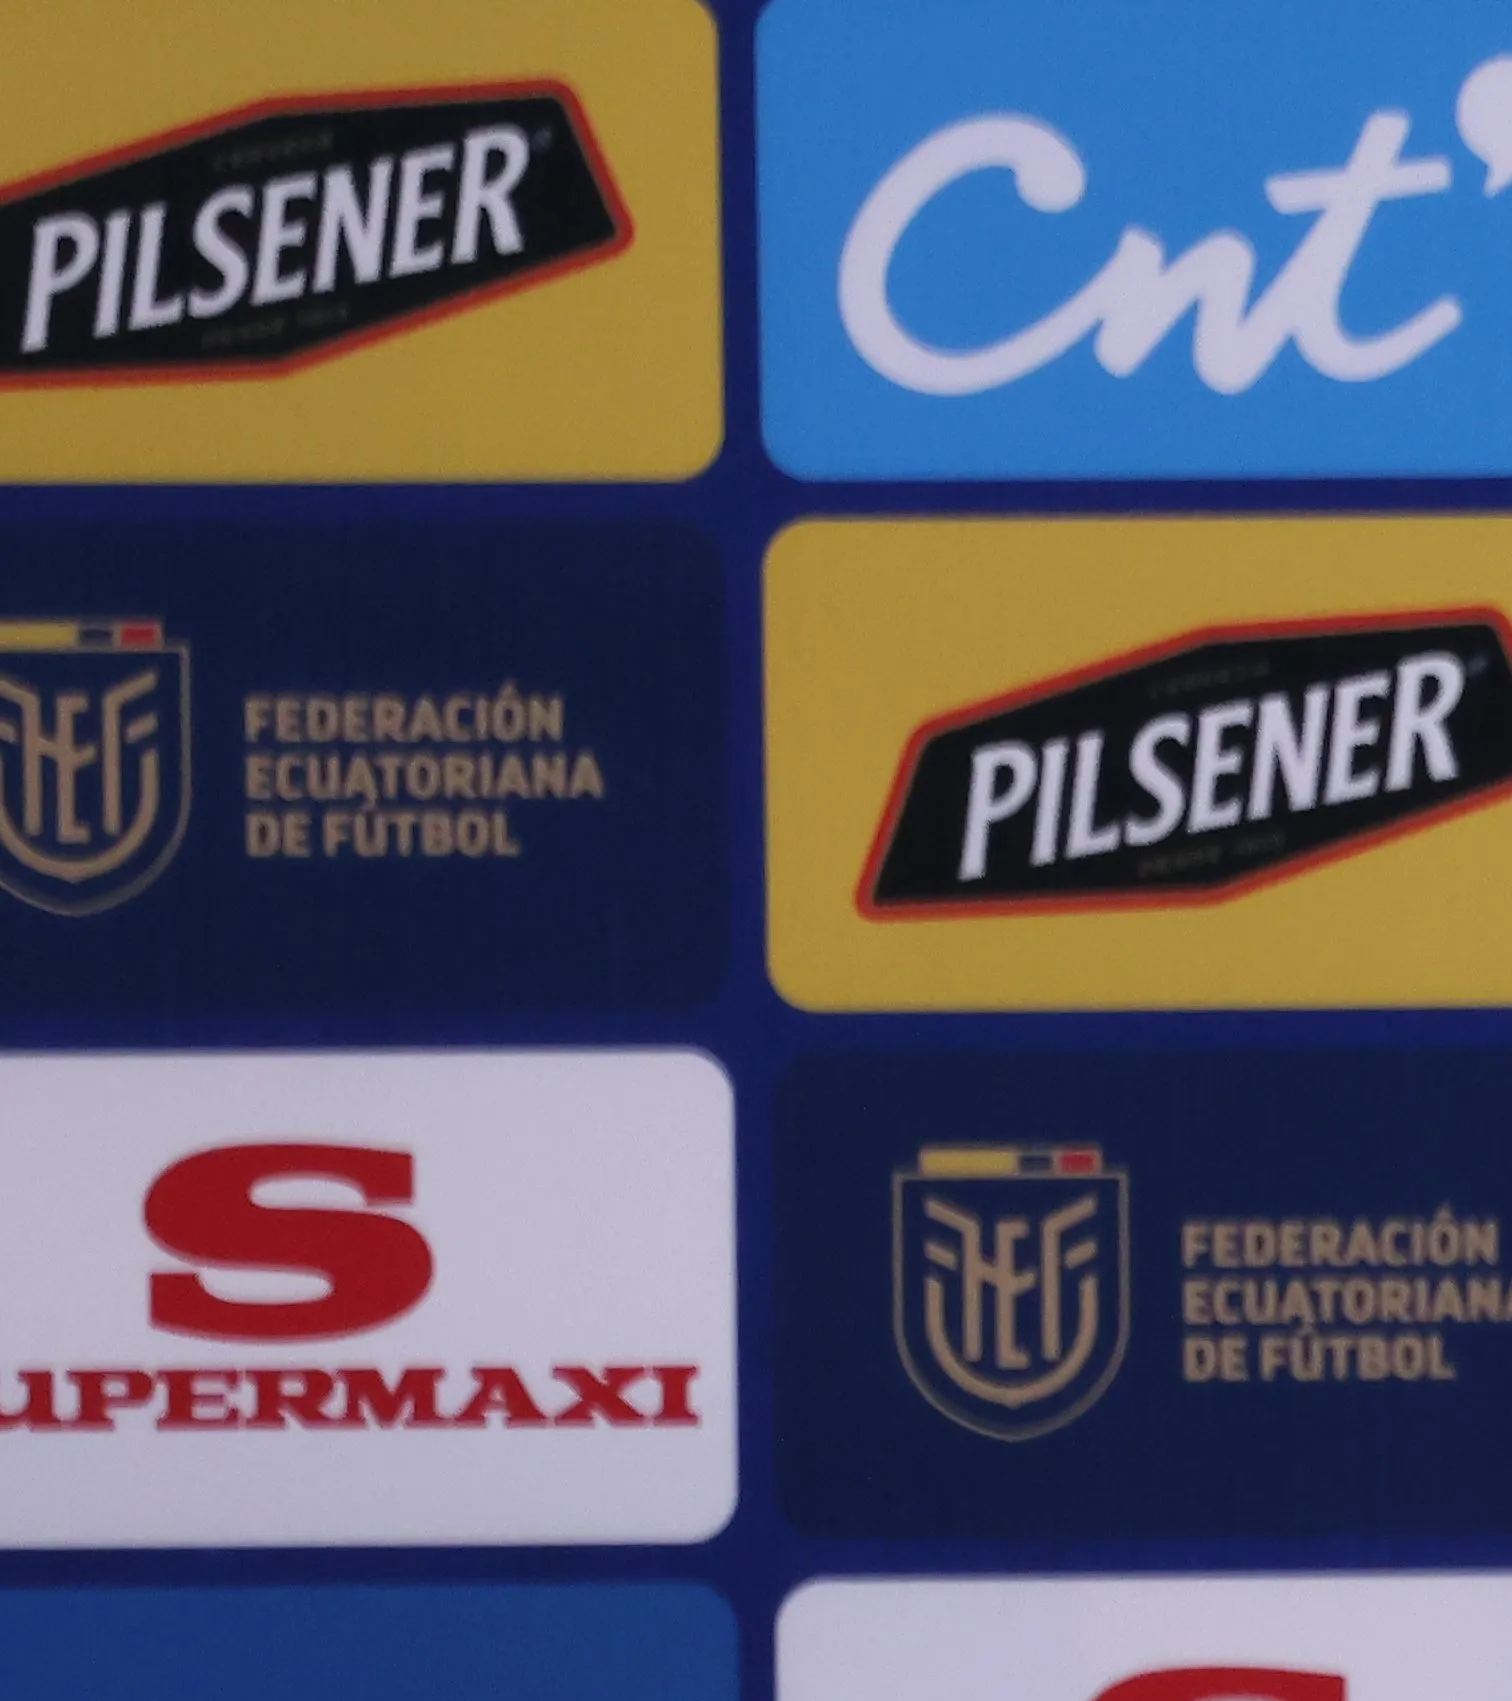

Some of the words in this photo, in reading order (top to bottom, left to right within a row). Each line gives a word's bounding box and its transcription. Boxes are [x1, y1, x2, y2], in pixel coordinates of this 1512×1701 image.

[20, 122, 531, 353] PILSENER
[244, 680, 564, 742] FEDERACIÓN
[244, 752, 604, 800] ECUATORIANA
[956, 649, 1466, 882] PILSENER
[246, 812, 309, 857] DE
[322, 797, 520, 858] FÚTBOL
[142, 1142, 434, 1346] S
[1181, 1204, 1499, 1267] FEDERACIÓN
[1182, 1336, 1249, 1383] DE
[1260, 1320, 1455, 1382] FÚTBOL
[0, 1361, 702, 1433] UPERMAXI
